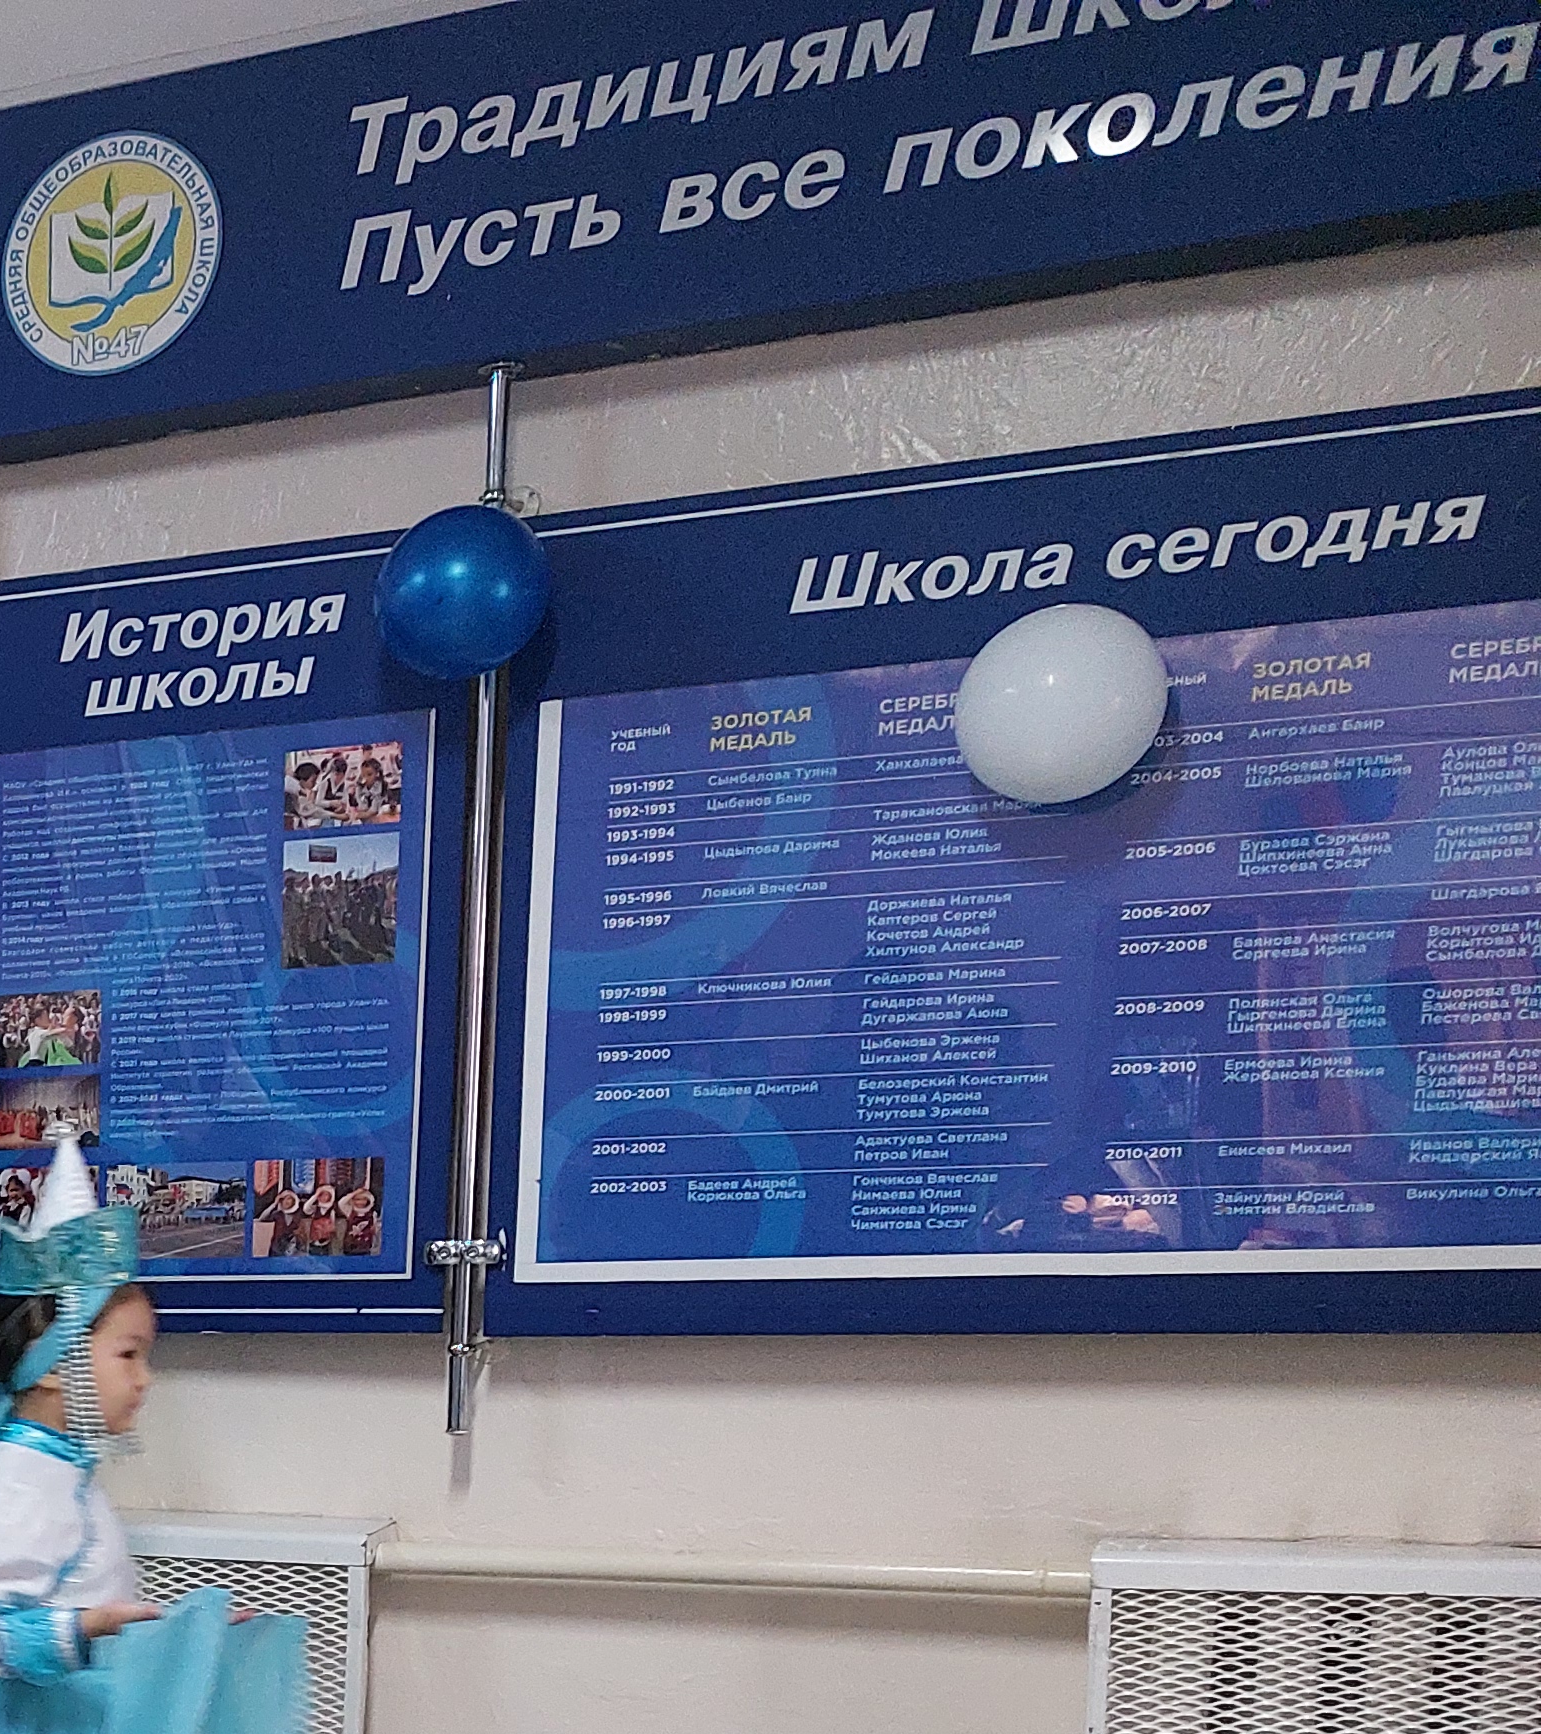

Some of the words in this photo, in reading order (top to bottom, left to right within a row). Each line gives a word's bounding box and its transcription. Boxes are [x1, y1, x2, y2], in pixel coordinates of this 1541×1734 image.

[349, 7, 935, 186] Традициям
[340, 194, 621, 295] Пусть
[659, 148, 845, 234] все
[883, 22, 1541, 194] поколения
[15, 139, 215, 242] ОБЩЕОБРАЗОВАТЕЛЬНАЯ
[174, 237, 215, 316] ШКОЛА
[9, 249, 43, 343] СРЕДНЯЯ
[70, 324, 150, 366] №47
[788, 542, 1075, 615] Школа
[1105, 493, 1488, 580] сегодня
[59, 593, 347, 663] История
[1450, 635, 1541, 660] СЕРЕБР
[1252, 651, 1372, 680] ЗОЛОТАЯ
[1448, 660, 1541, 684] МЕДАЛ
[83, 655, 316, 718] школы
[1250, 677, 1353, 703] МЕДАЛЬ
[879, 693, 959, 715] СЕРЕБР
[710, 706, 813, 732] ЗОЛОТАЯ
[878, 714, 955, 737] МЕДАЛ
[610, 723, 672, 741] УЧЕБНЫЙ
[709, 729, 797, 752] МЕДАЛЬ
[1154, 730, 1225, 748] 03-2004
[610, 740, 637, 753] ГОД
[608, 779, 675, 795] 1991-1992
[607, 802, 676, 819] 1992-1993
[606, 826, 676, 843] 1993-1994
[871, 831, 941, 847] Жданова
[944, 827, 989, 840] Юлия
[605, 850, 675, 867] 1994-1995
[1124, 841, 1217, 860] 2005-2006
[758, 880, 829, 896] Вячеслав
[603, 890, 673, 906] 1995-1996
[949, 891, 1013, 907] Наталья
[942, 909, 998, 923] Сергей
[1120, 902, 1212, 921] 2006-2007
[602, 914, 672, 930] 1996-1997
[866, 928, 929, 942] Кочетов
[931, 923, 991, 939] Андрей
[940, 937, 1025, 953] Александр
[1118, 938, 1208, 955] 2007-2008
[790, 976, 833, 990] Юлия
[947, 967, 1007, 982] Марина
[599, 985, 668, 1001] 1997-1998
[946, 992, 996, 1007] Ирина
[598, 1008, 668, 1024] 1998-1999
[1114, 999, 1205, 1017] 2008-2009
[596, 1048, 672, 1063] 1999-2000
[1110, 1060, 1197, 1076] 2009-2010
[958, 1071, 1050, 1087] Константин
[594, 1086, 671, 1102] 2000-2001
[755, 1080, 820, 1097] Дмитрий
[591, 1142, 667, 1156] 2001-2002
[1104, 1146, 1183, 1160] 2010-2011
[590, 1180, 667, 1195] 2002-2003
